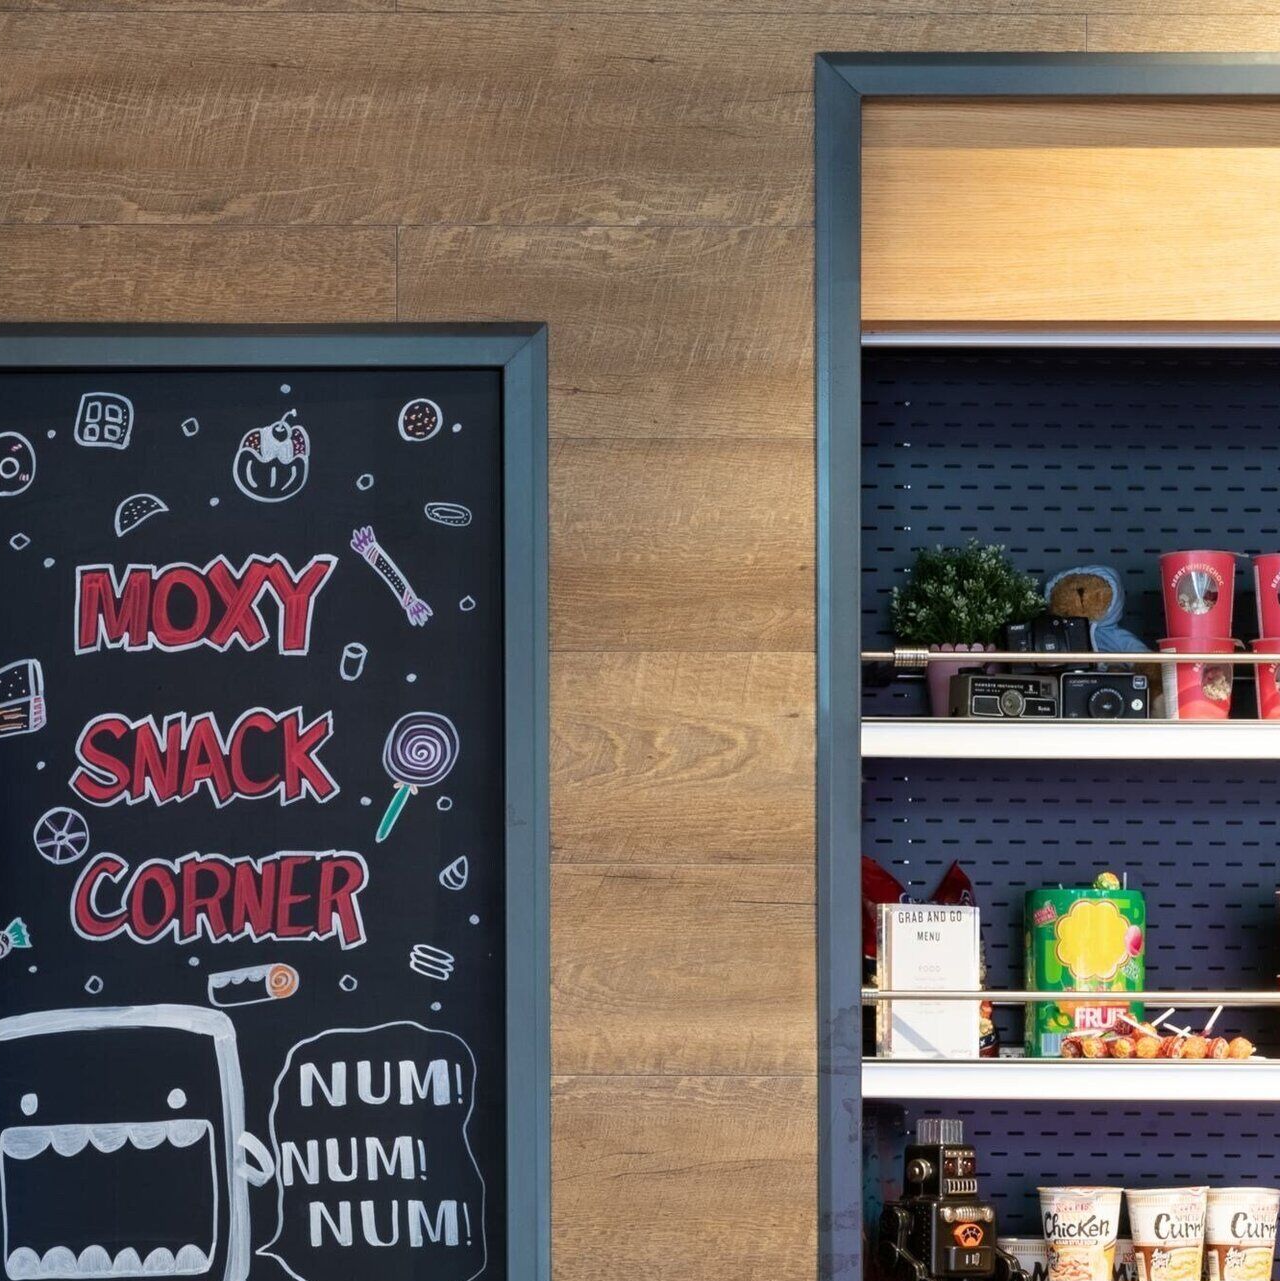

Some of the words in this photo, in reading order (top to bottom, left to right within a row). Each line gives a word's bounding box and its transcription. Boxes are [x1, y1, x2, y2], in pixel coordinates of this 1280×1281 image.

[75, 554, 338, 654] MOXY
[68, 706, 340, 808] SNACK
[70, 849, 370, 950] CORNER
[898, 912, 924, 924] GRAB
[927, 911, 946, 923] AND
[950, 910, 962, 922] GO
[917, 931, 941, 942] MENU
[299, 1058, 464, 1107] NUM!
[280, 1136, 427, 1187] NUM!
[309, 1200, 472, 1248] NUM!
